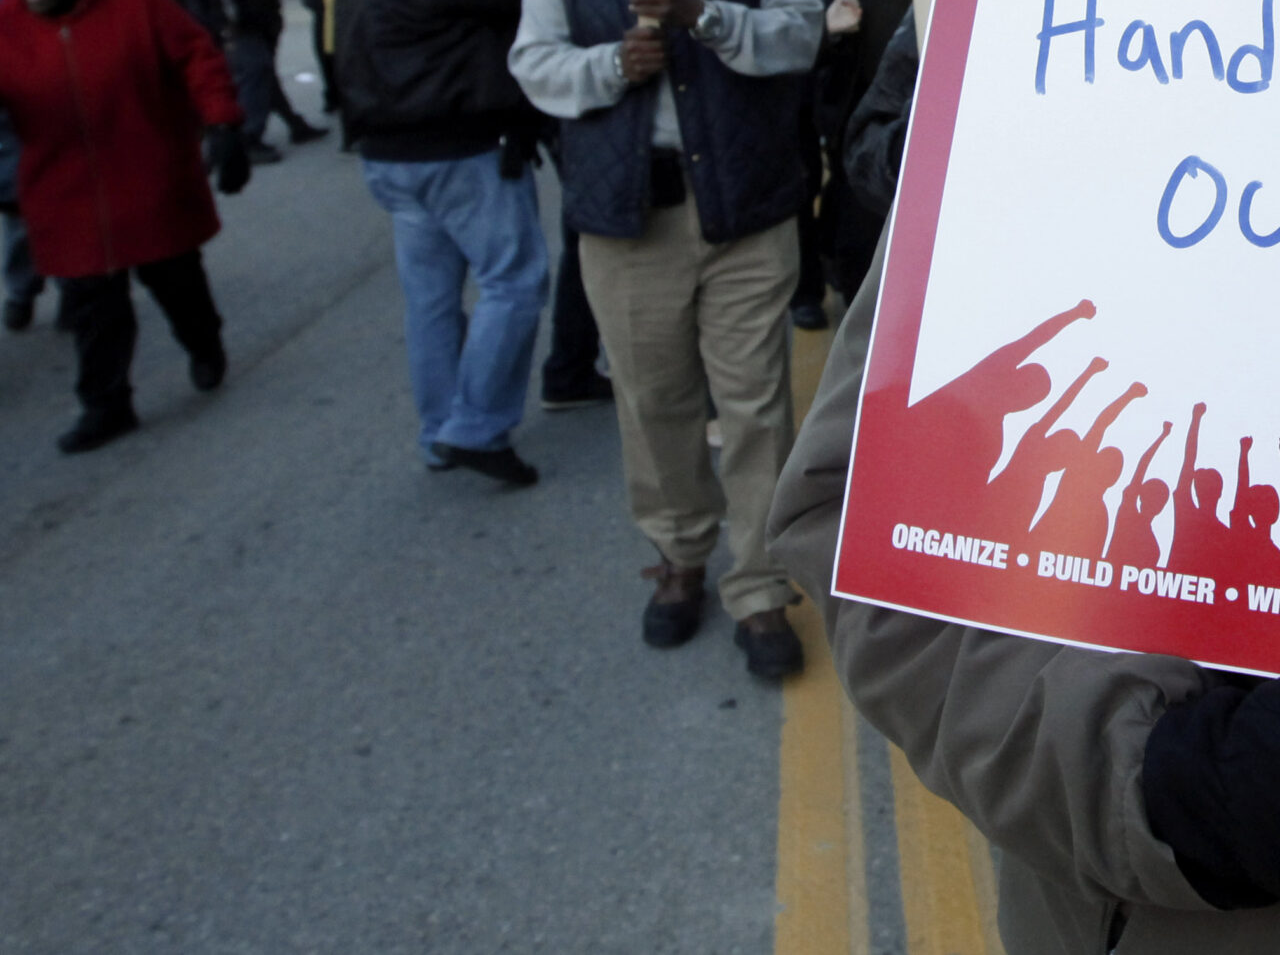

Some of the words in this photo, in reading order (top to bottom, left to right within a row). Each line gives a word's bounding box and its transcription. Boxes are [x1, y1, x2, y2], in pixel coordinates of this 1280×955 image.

[892, 522, 1010, 571] ORGANIZE
[1037, 550, 1114, 589] BUILD
[1120, 563, 1216, 605] POWER
